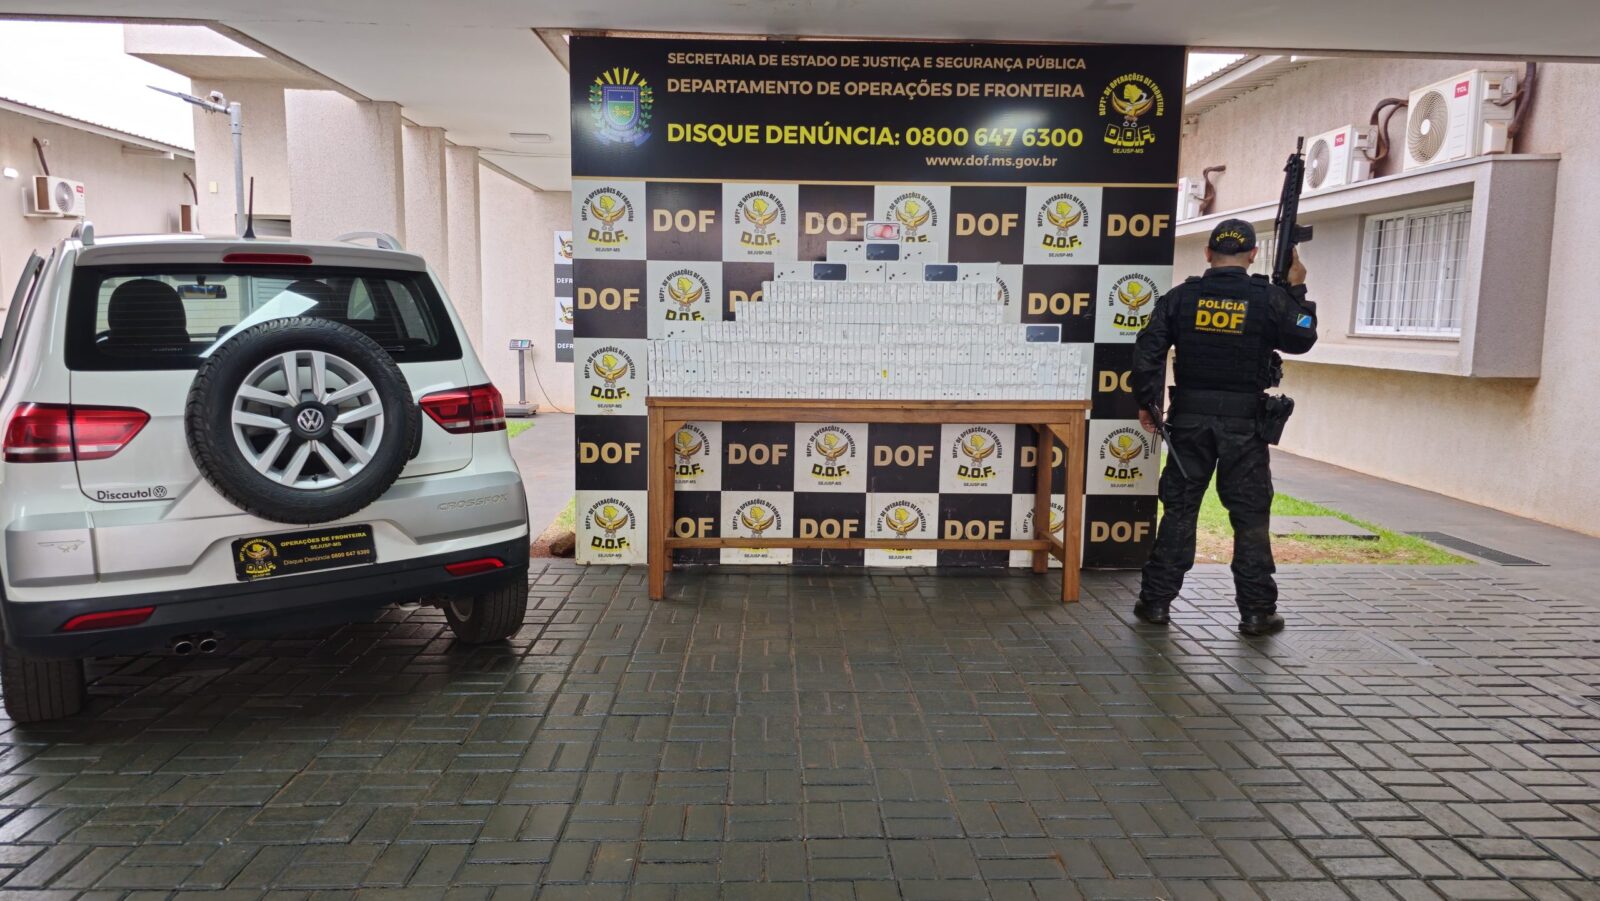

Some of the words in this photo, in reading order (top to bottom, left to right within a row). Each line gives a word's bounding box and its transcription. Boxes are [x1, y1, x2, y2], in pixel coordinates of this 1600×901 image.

[668, 53, 755, 66] SECRETARIA
[759, 54, 778, 66] DE
[782, 55, 837, 67] ESTADO
[841, 56, 859, 68] DE
[862, 56, 920, 71] JUSTIÇA
[924, 57, 932, 68] E
[936, 58, 1023, 72] SEGURANÇA
[1026, 54, 1086, 70] PÚBLICA
[667, 79, 812, 95] DEPARTAMENTO
[817, 82, 840, 95] DE
[844, 80, 952, 100] OPERAÇÕES
[956, 83, 980, 96] DE
[984, 83, 1084, 98] FRONTEIRA
[668, 124, 759, 146] DISQUE
[766, 121, 900, 146] DENÚNCIA:
[906, 127, 968, 146] 0800
[974, 128, 1017, 146] 647
[1022, 128, 1082, 147] 6300
[926, 155, 1058, 168] www.dof.ms.gov.br
[653, 209, 715, 232] DOF
[805, 212, 866, 234] DOF
[956, 214, 1018, 236] DOF
[1107, 214, 1170, 236] DOF
[1216, 231, 1244, 243] POLÍCIA
[578, 288, 640, 310] DOF
[1028, 293, 1090, 315] DOF
[1199, 299, 1245, 311] POLÍCIA
[1196, 311, 1245, 328] DOF
[1099, 370, 1132, 392] DO
[580, 442, 640, 464] DOF
[728, 444, 788, 464] DOF
[874, 446, 934, 467] DOF
[97, 488, 151, 500] Discautol
[438, 494, 508, 510] CROSSFOX
[675, 518, 714, 538] OF
[800, 519, 859, 538] DOF
[944, 520, 1004, 540] DOF
[1091, 522, 1149, 542] DOF
[280, 538, 320, 546] OPERAÇÕES
[331, 532, 366, 540] FRONTEIRA
